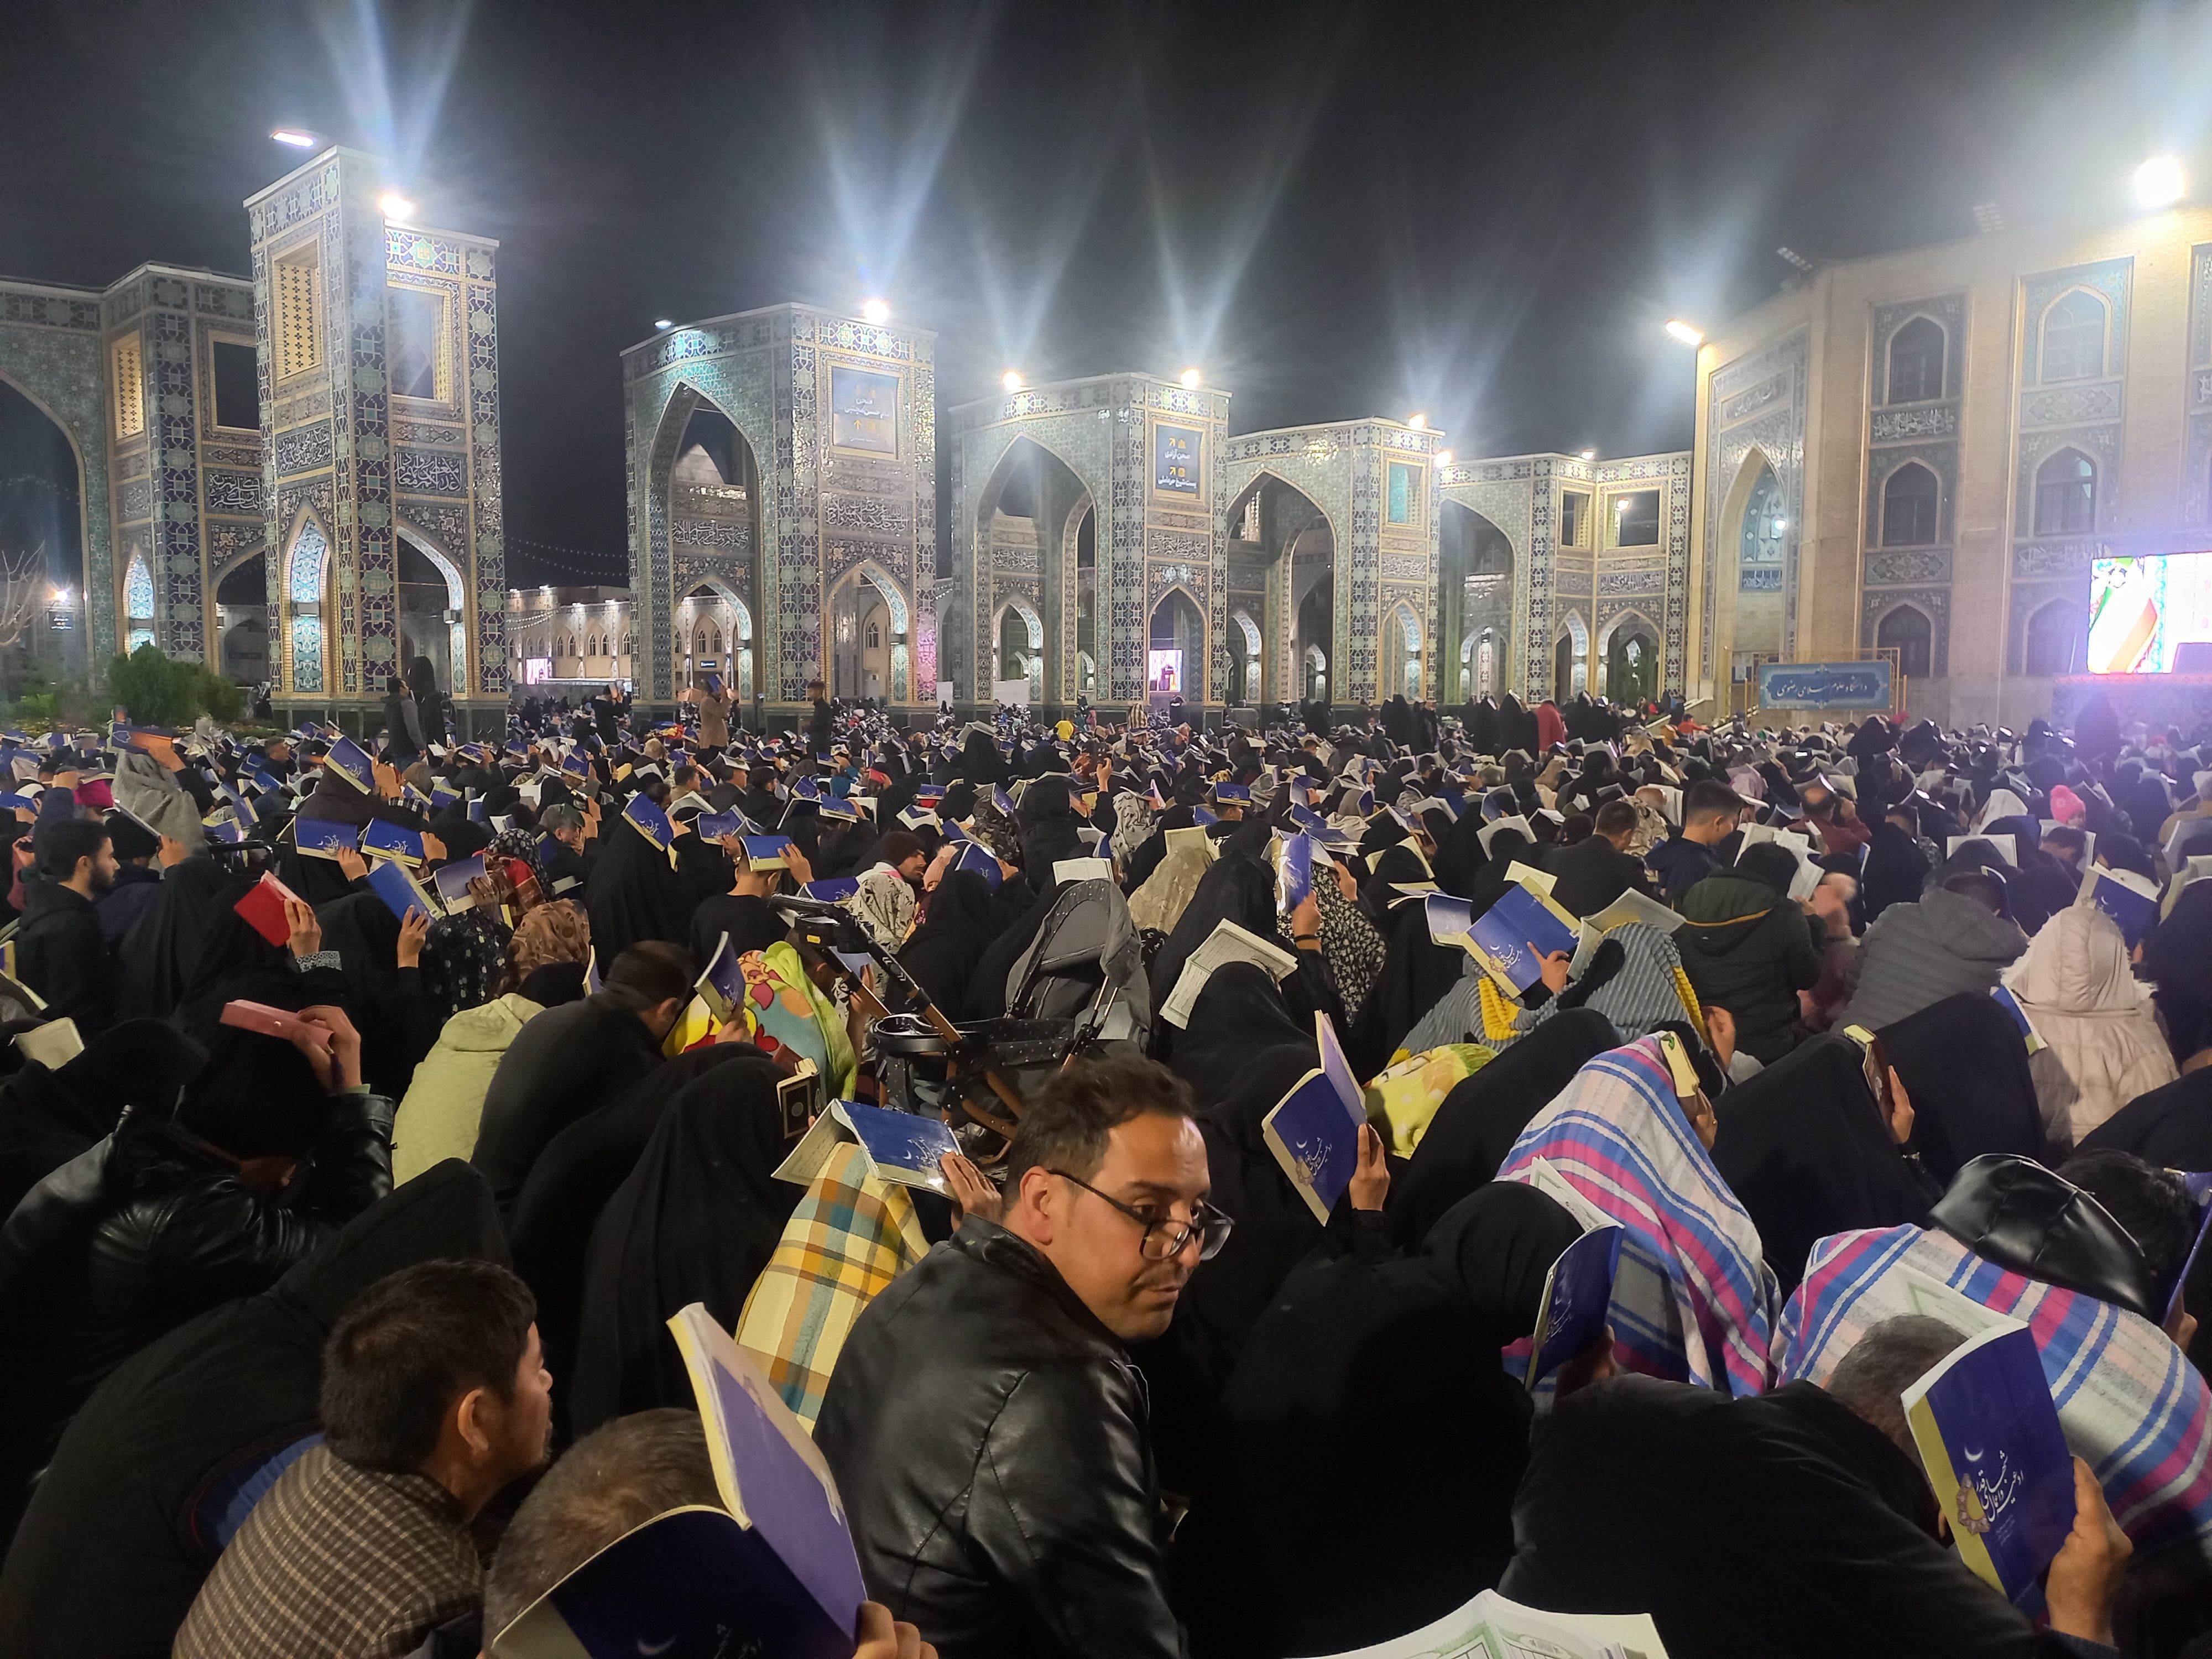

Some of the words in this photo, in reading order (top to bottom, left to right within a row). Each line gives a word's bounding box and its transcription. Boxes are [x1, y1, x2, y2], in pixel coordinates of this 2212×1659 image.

[1164, 448, 1177, 460] آزادی
[1777, 679, 1797, 697] رضوی
[1831, 682, 1844, 691] علوم
[1845, 675, 1867, 692] دانشگاه
